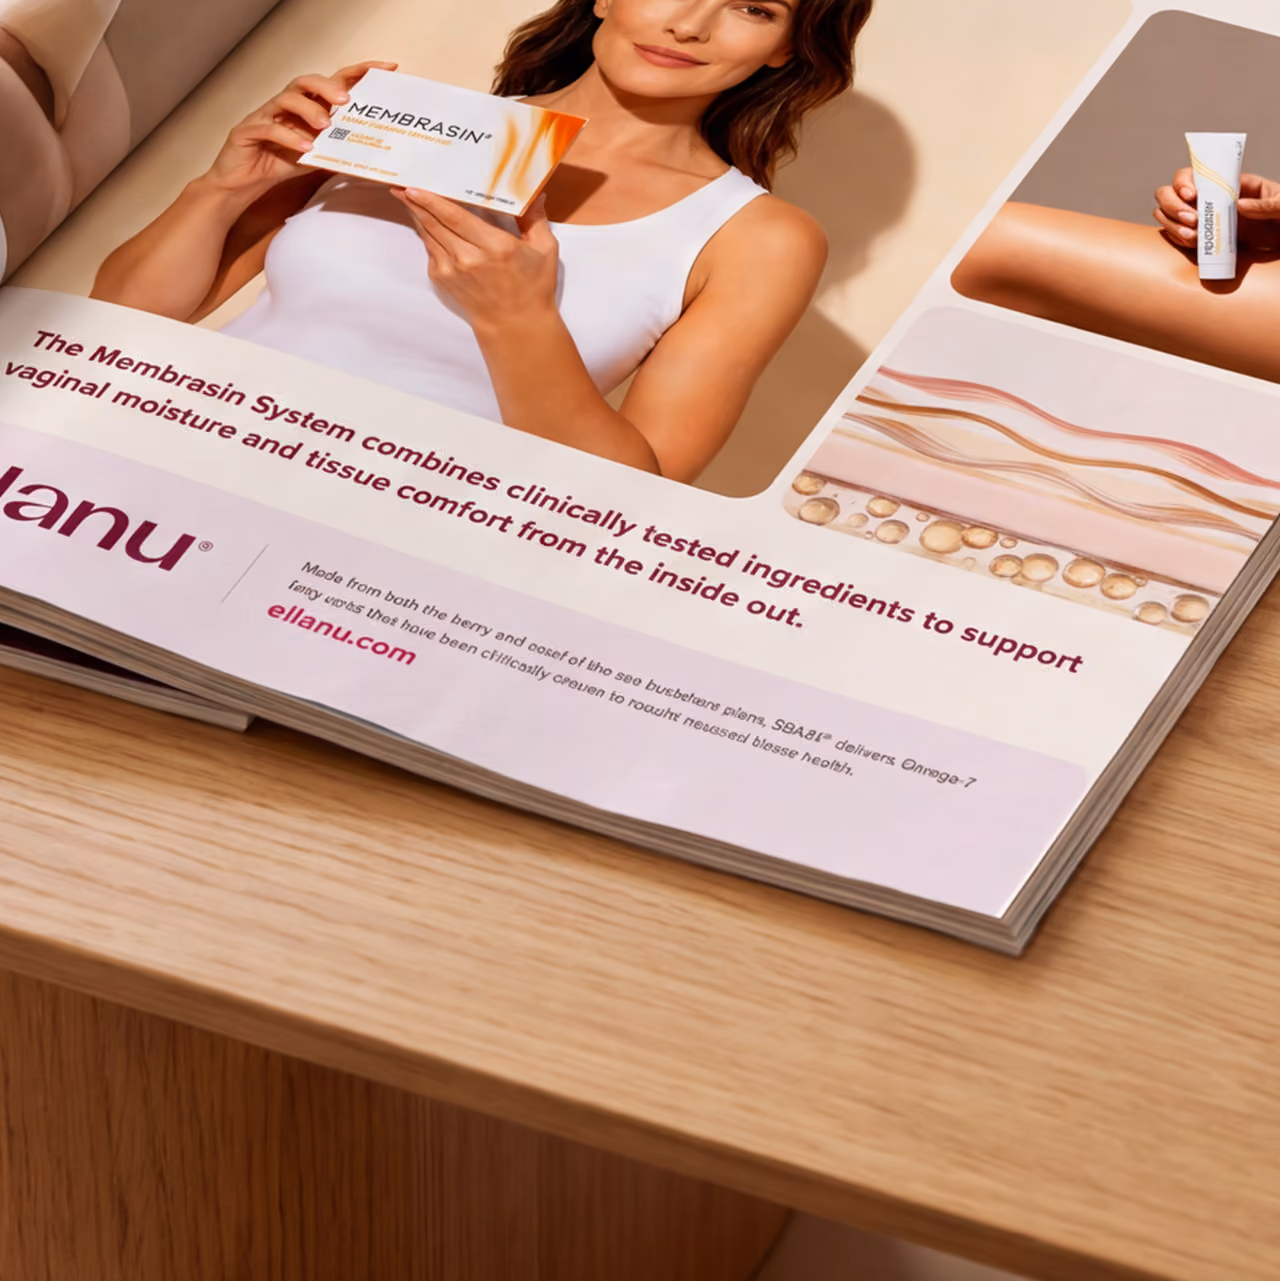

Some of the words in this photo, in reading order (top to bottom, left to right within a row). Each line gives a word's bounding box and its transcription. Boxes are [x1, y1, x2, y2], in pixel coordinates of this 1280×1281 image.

[5, 362, 111, 398] vaginal
[112, 391, 237, 438] moisture
[242, 433, 304, 460] and
[306, 451, 390, 491] tissue
[397, 486, 513, 533] comfort
[517, 521, 586, 557] from
[594, 547, 643, 575] the
[649, 568, 739, 606] inside
[747, 601, 802, 628] out.
[33, 330, 83, 356] The
[88, 346, 246, 405] Membrasin
[251, 396, 355, 442] System
[362, 437, 500, 490] combines
[507, 485, 637, 537] clinically
[643, 525, 740, 568] tested
[742, 560, 915, 622] ingredients
[923, 612, 954, 634] to
[961, 628, 1083, 673] support
[268, 605, 416, 665] ellanu.com
[346, 577, 382, 597] from
[422, 605, 447, 620] the
[495, 632, 527, 647] and
[439, 633, 478, 654] been
[609, 691, 625, 704] to
